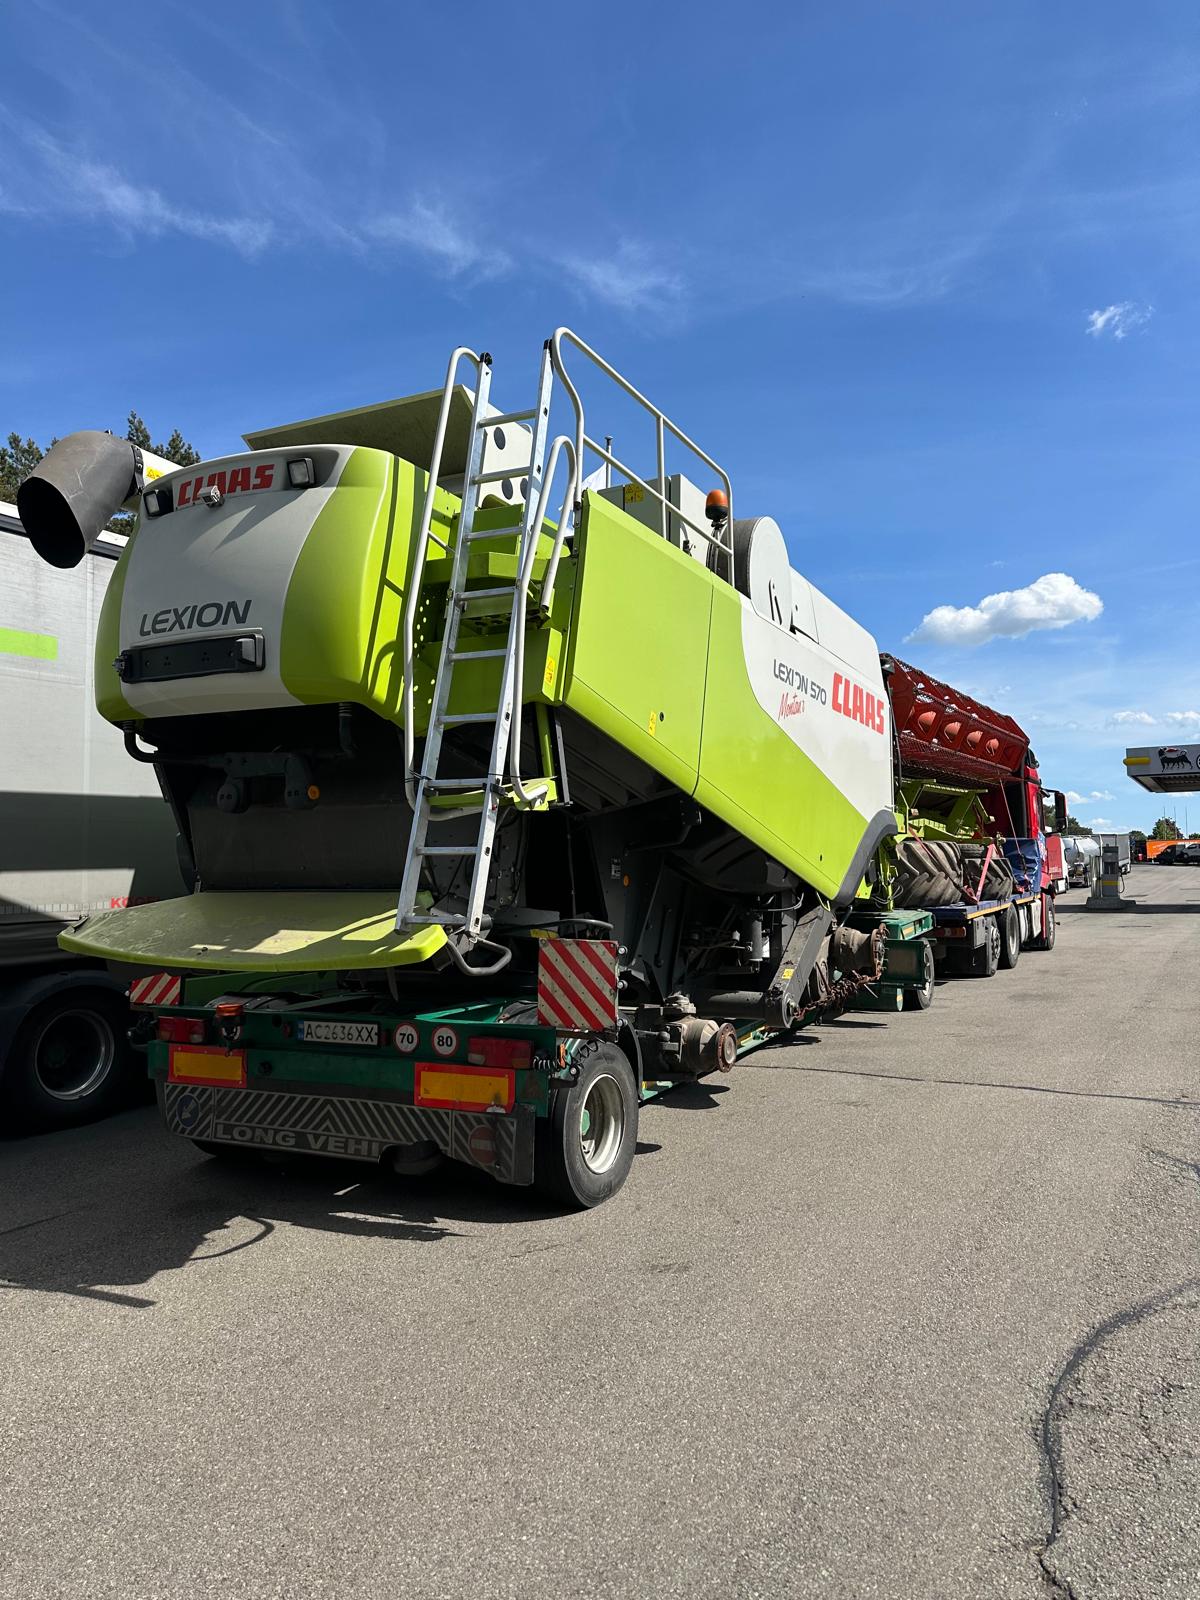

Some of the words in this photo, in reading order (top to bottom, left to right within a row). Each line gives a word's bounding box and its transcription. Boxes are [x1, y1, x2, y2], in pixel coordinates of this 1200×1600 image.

[178, 464, 275, 506] CLAAS
[140, 600, 252, 637] LEXION
[773, 659, 808, 695] LEXION
[810, 680, 827, 705] 570
[831, 671, 884, 735] CLAAS
[305, 1023, 374, 1043] AC2636XX
[400, 1033, 414, 1044] 70
[437, 1035, 453, 1047] 80
[216, 1124, 296, 1146] LONG
[307, 1134, 379, 1157] VEHI
